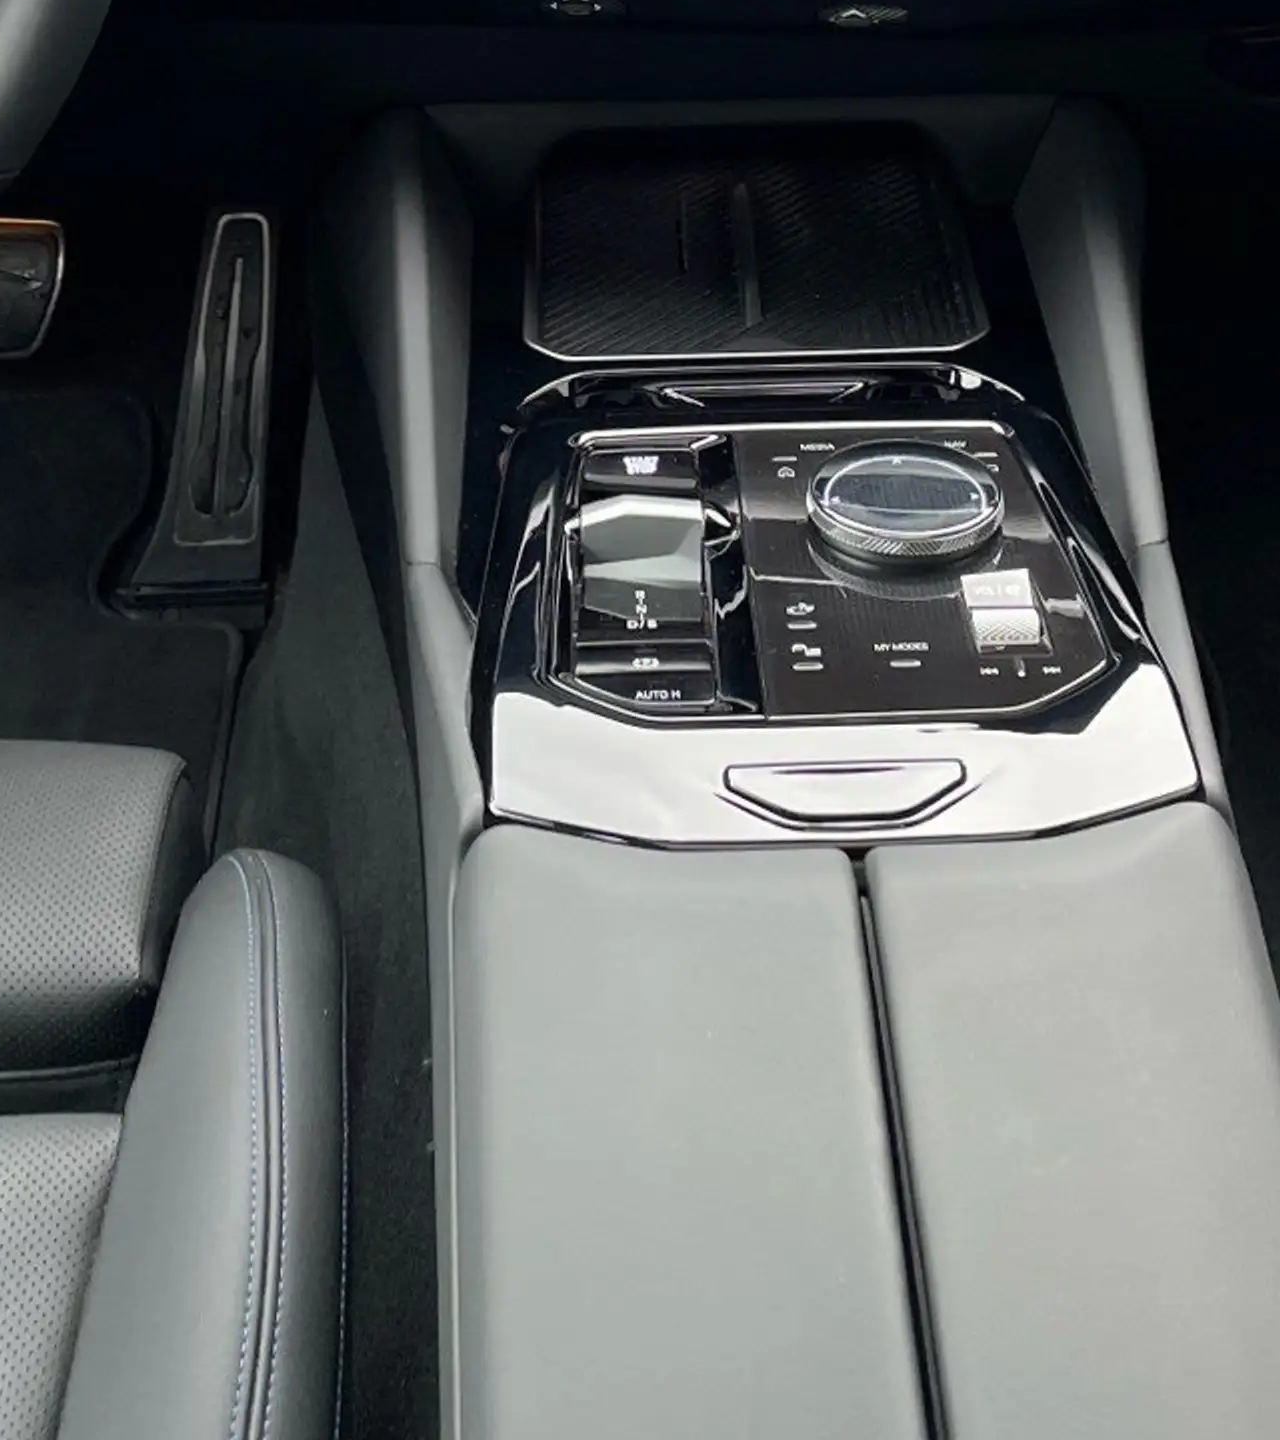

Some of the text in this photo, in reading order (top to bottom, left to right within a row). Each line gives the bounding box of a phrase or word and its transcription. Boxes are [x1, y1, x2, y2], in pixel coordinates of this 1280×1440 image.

[873, 642, 930, 652] MY MODES
[634, 689, 682, 700] AUTO H
